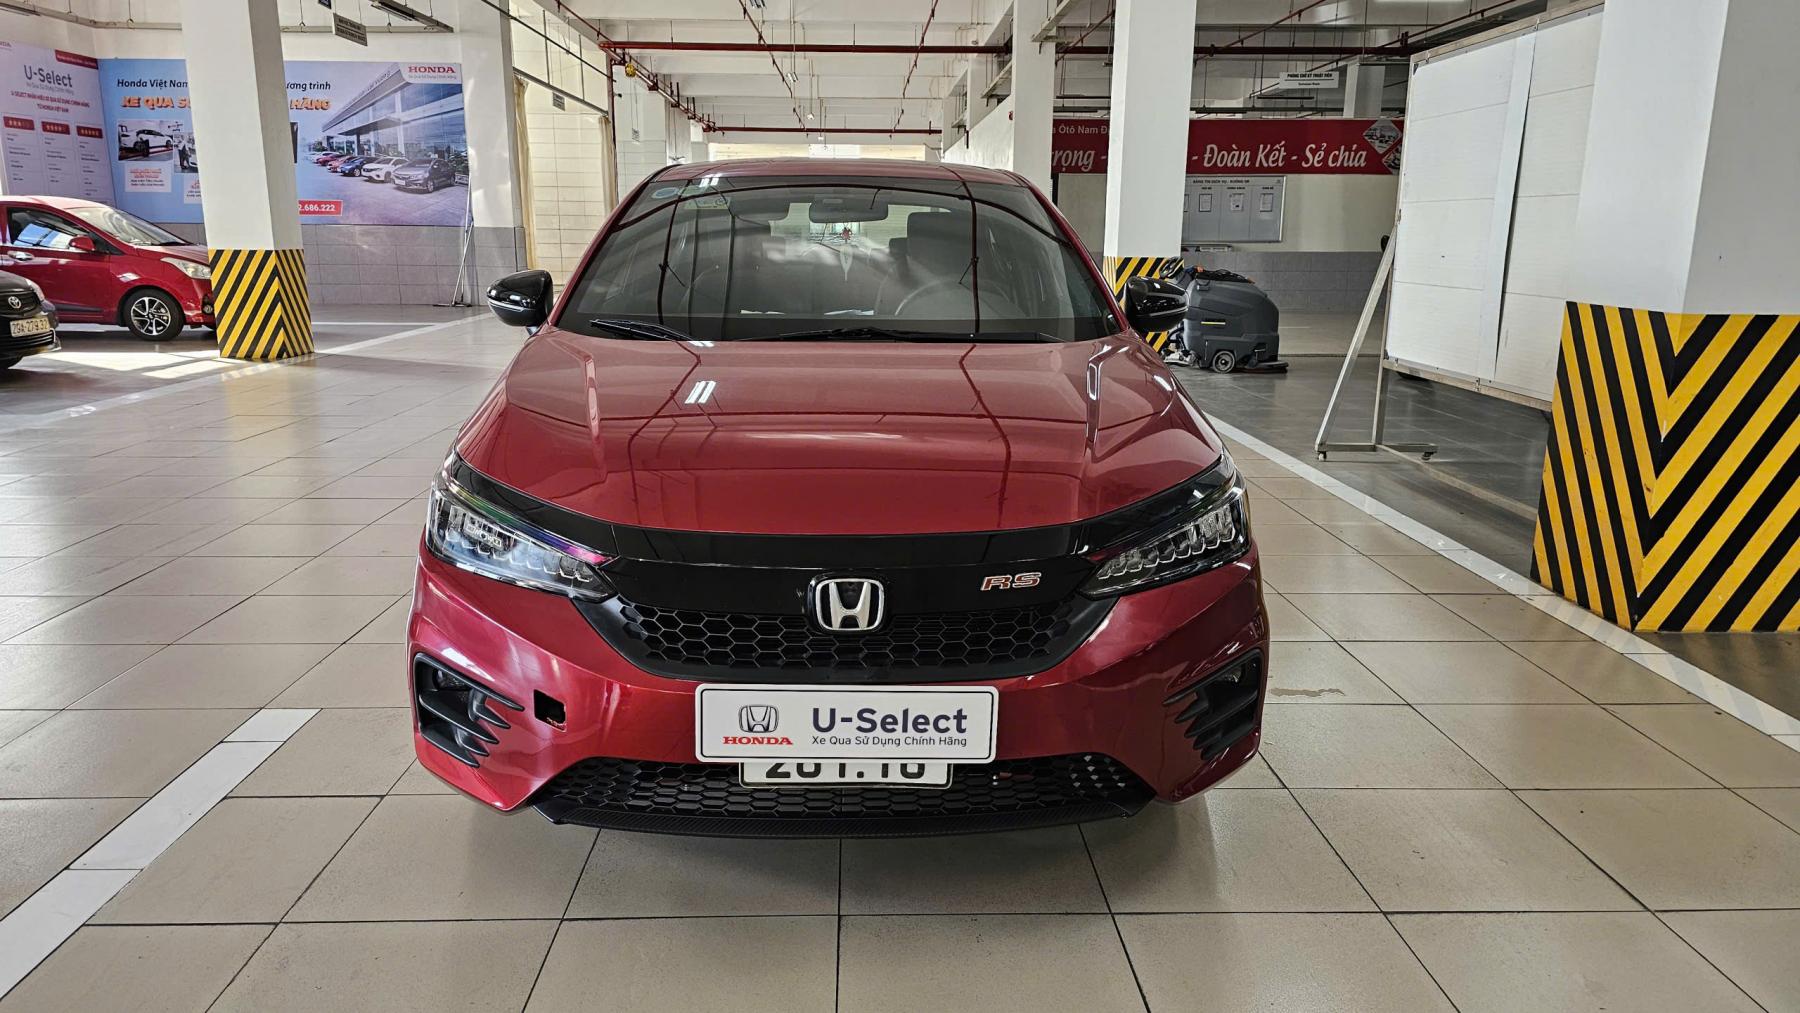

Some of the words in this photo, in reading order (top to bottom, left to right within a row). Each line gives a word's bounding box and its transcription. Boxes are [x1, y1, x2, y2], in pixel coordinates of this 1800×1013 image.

[24, 65, 72, 87] U-Select
[408, 66, 456, 74] HONDA
[117, 79, 147, 88] Honda
[149, 79, 168, 90] Việt
[121, 96, 141, 108] XE
[143, 96, 175, 110] QUA
[1059, 124, 1076, 134] Ôtô
[1077, 126, 1099, 134] Nam
[1052, 150, 1096, 172] rọng
[1203, 144, 1251, 168] Đoàn
[1255, 141, 1287, 168] Kết
[1302, 142, 1326, 168] Sẻ
[980, 572, 1042, 591] RS
[812, 707, 968, 734] U-Select
[723, 736, 793, 745] HONDA
[811, 736, 826, 745] Xe
[829, 736, 851, 745] Qua
[855, 734, 870, 745] Sử
[872, 736, 901, 747] Dụng
[904, 735, 936, 745] Chính
[938, 736, 967, 748] Hãng
